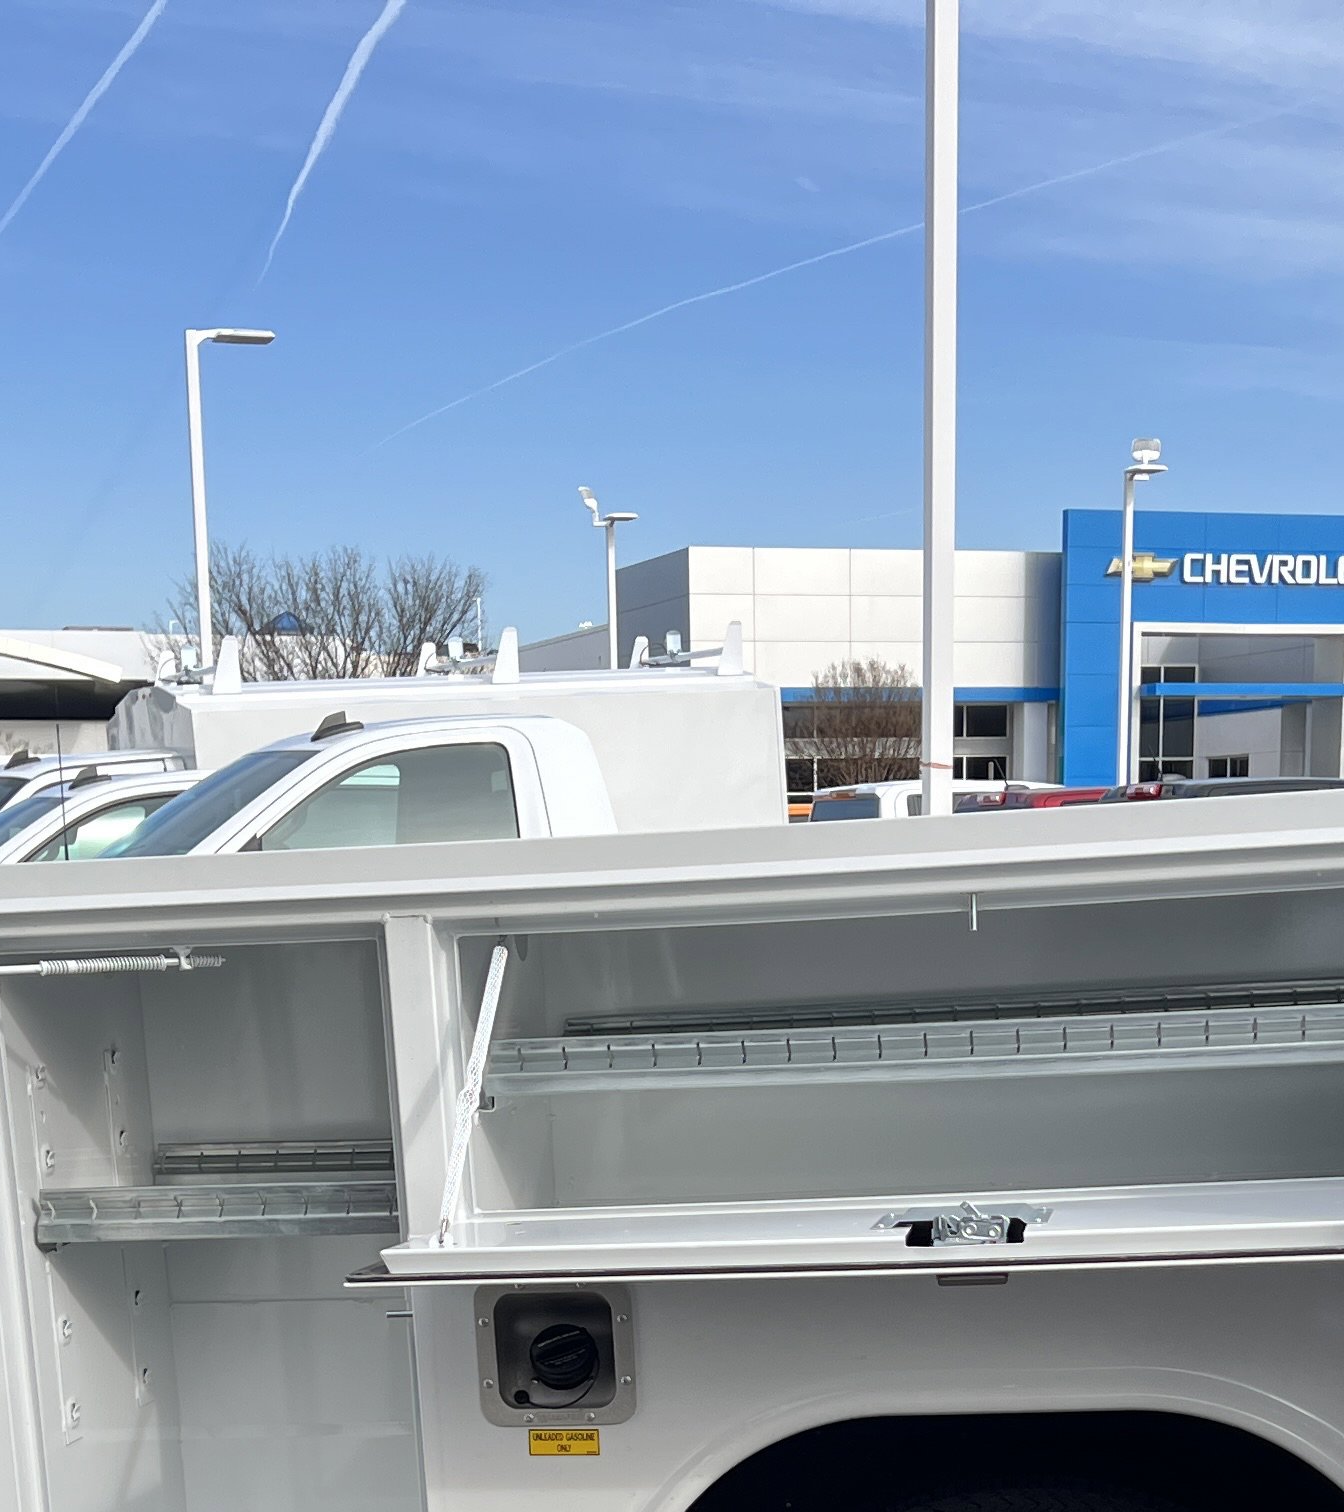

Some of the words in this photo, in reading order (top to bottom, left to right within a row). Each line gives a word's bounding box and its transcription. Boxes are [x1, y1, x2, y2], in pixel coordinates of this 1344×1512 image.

[533, 1432, 564, 1441] UNLEADED
[566, 1432, 595, 1441] GASOLINE
[557, 1444, 572, 1453] ONLY
